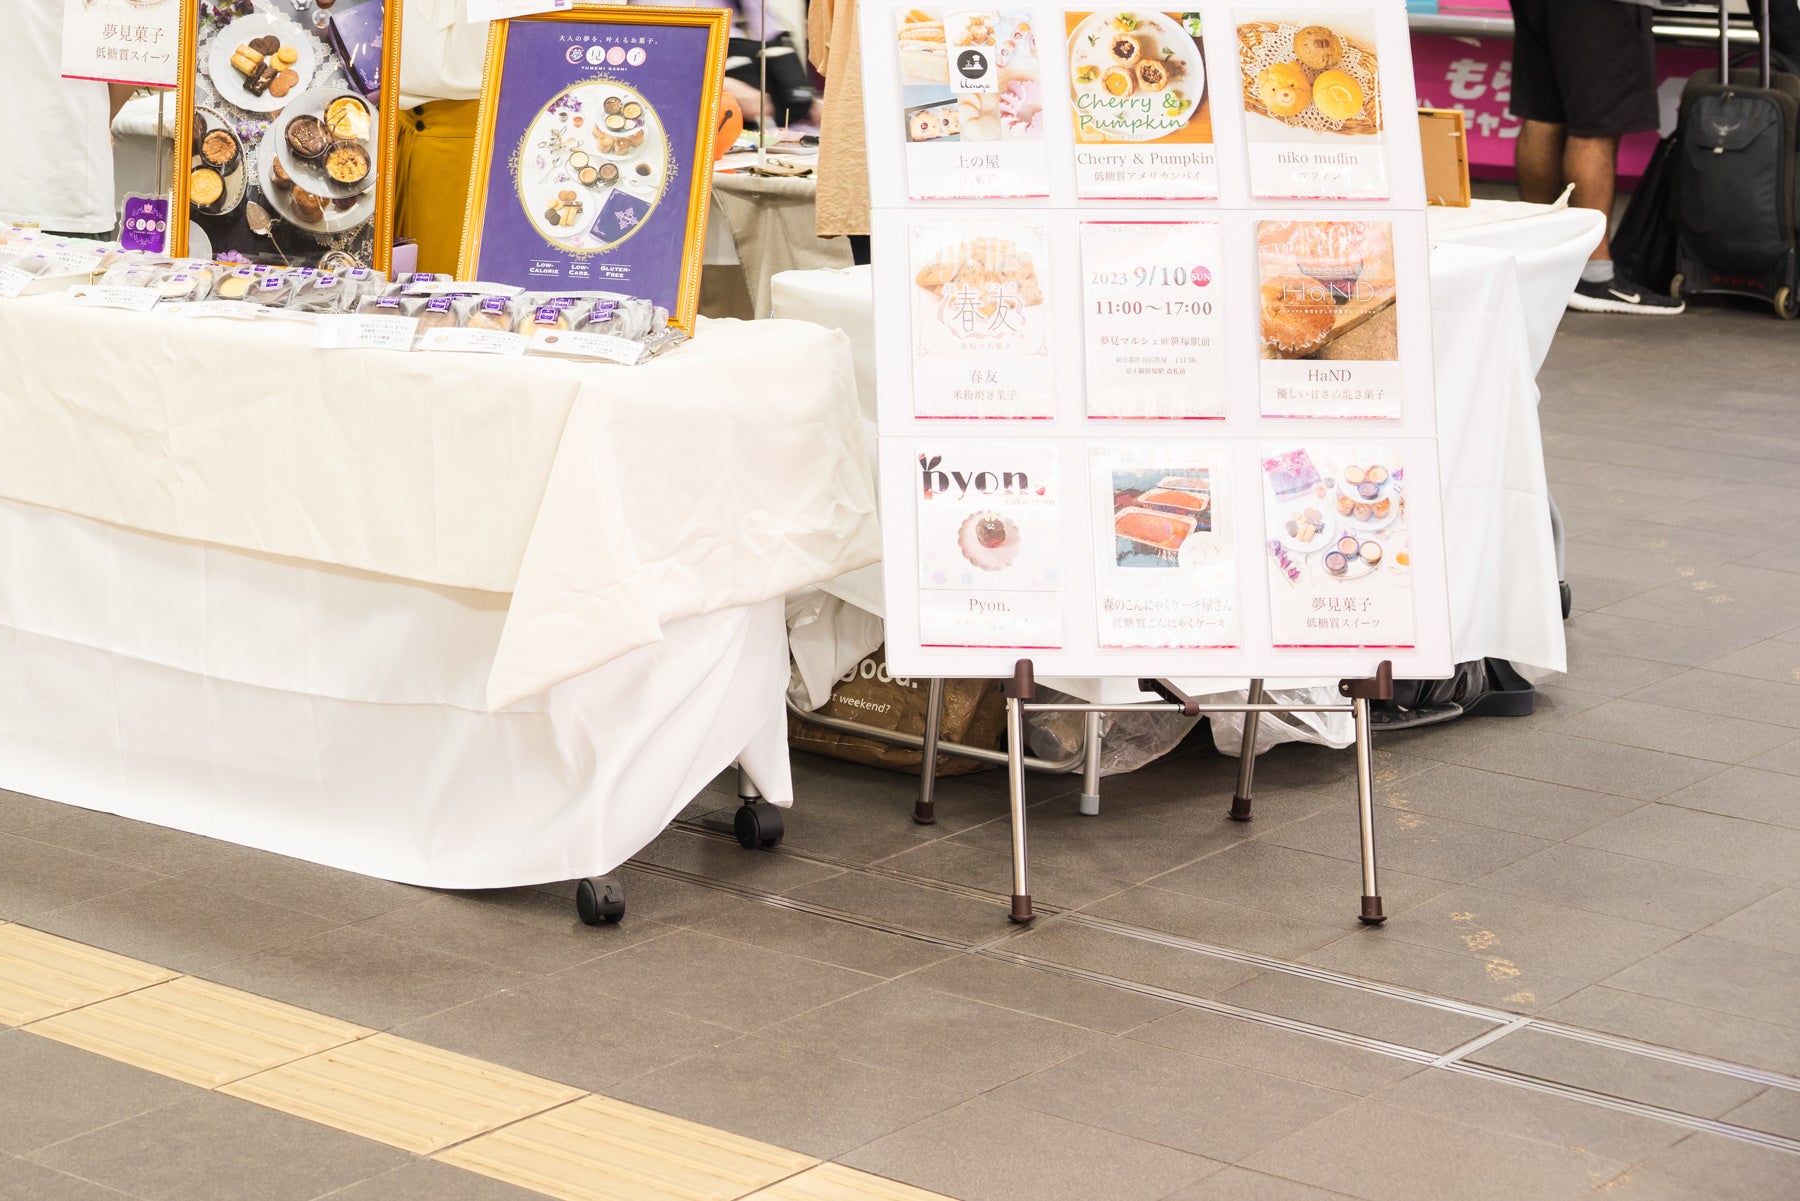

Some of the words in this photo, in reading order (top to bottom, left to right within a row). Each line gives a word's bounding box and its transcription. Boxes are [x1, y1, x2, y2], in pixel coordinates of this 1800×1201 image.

[103, 23, 164, 44] 夢見菓子
[96, 46, 170, 63] 低糖質スイーツ
[1077, 93, 1152, 113] Cherry
[1163, 92, 1178, 108] &
[1080, 114, 1186, 134] Pumpkin
[957, 154, 1000, 170] 上の屋
[1077, 153, 1127, 168] Cherry
[1133, 153, 1144, 164] &
[1151, 153, 1214, 168] Pumpkin
[1277, 151, 1309, 165] niko
[1314, 151, 1358, 165] muffin
[1091, 272, 1127, 285] 2023
[1133, 266, 1187, 286] 9/10
[1191, 273, 1211, 282] SUN
[1283, 281, 1374, 302] HaND
[952, 286, 1019, 332] 春友
[969, 369, 998, 384] 春友
[1308, 369, 1351, 382] HaND
[970, 598, 1010, 614] Pyon.
[1311, 596, 1372, 612] 夢見菓子
[1306, 617, 1381, 629] 低糖質スイーツ
[839, 693, 891, 714] weekend?
